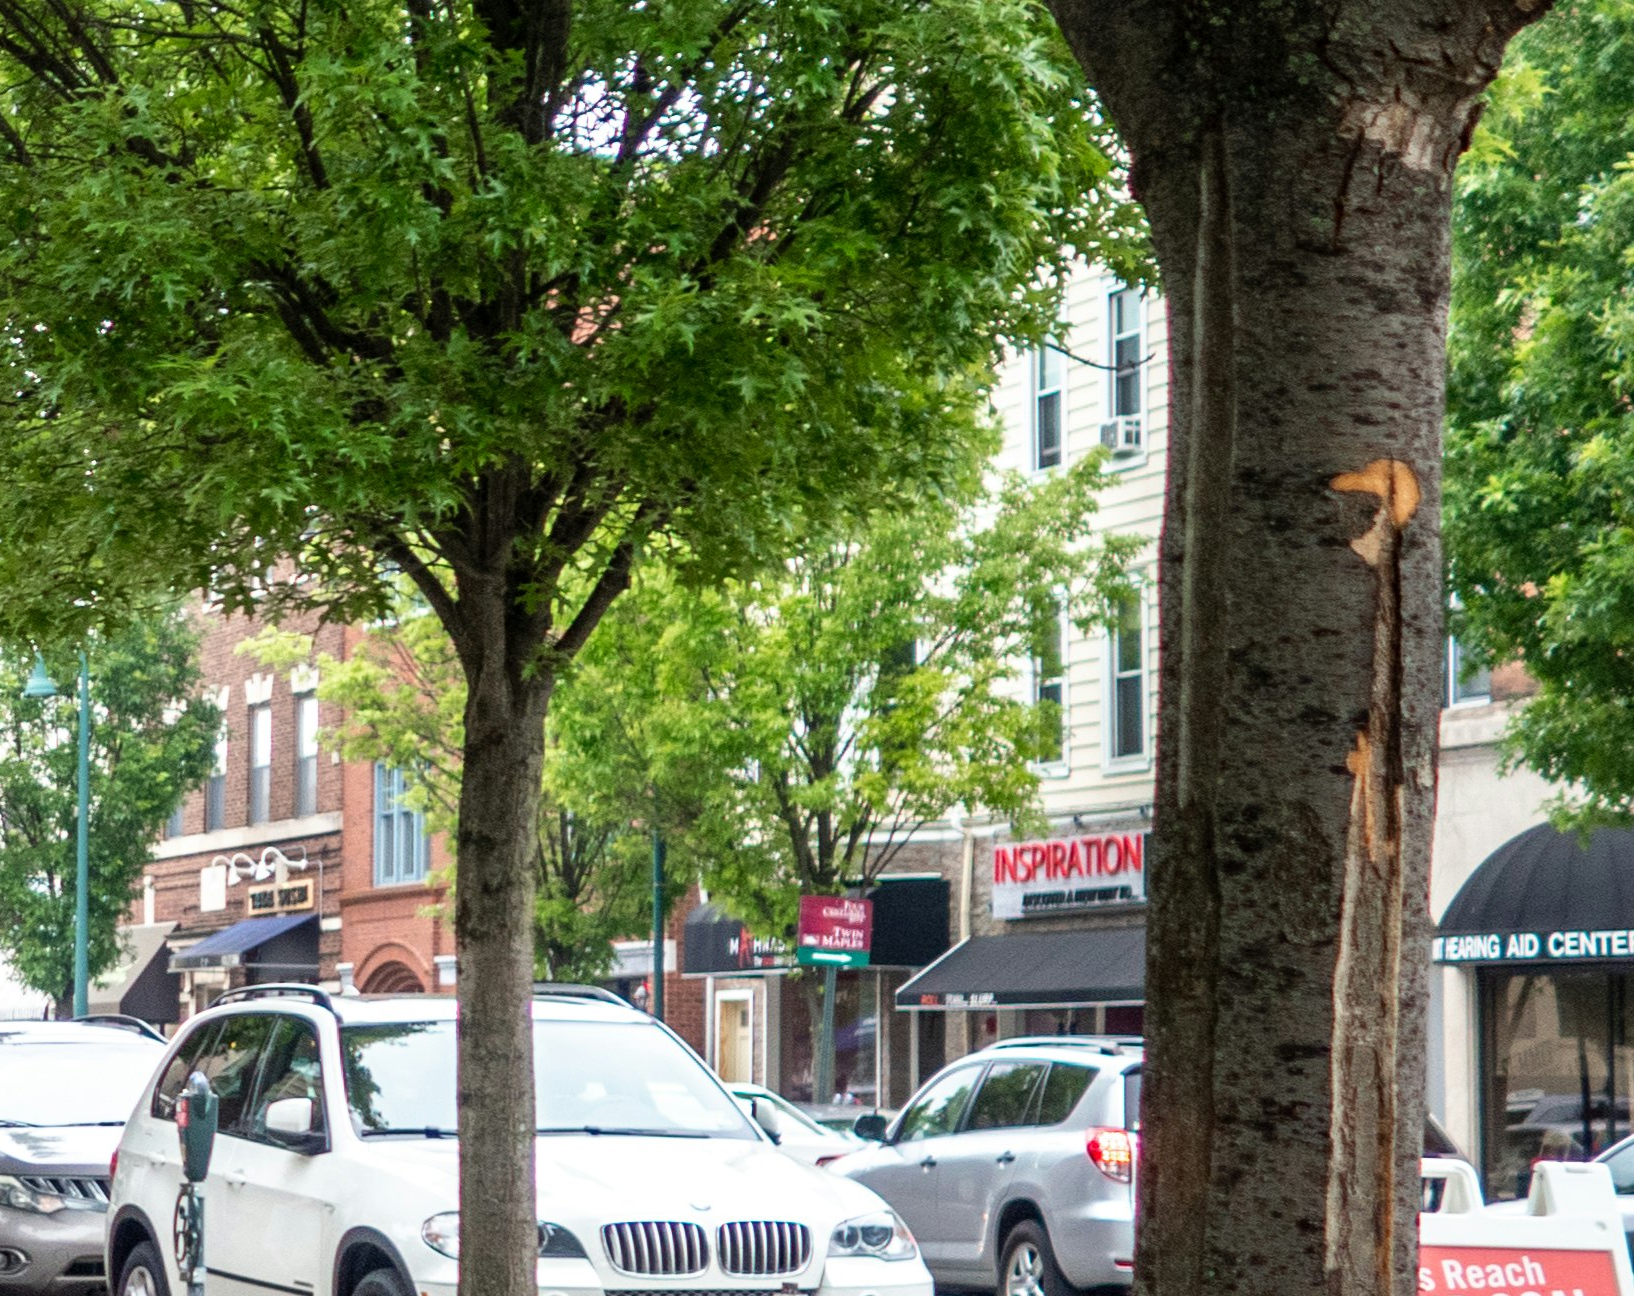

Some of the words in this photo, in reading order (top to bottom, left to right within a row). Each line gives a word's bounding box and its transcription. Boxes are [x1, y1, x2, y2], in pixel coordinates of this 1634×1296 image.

[994, 833, 1142, 884] INSPIRATION
[1445, 934, 1501, 961] HEARING
[1506, 933, 1540, 958] AID
[1441, 1256, 1546, 1290] Reach
